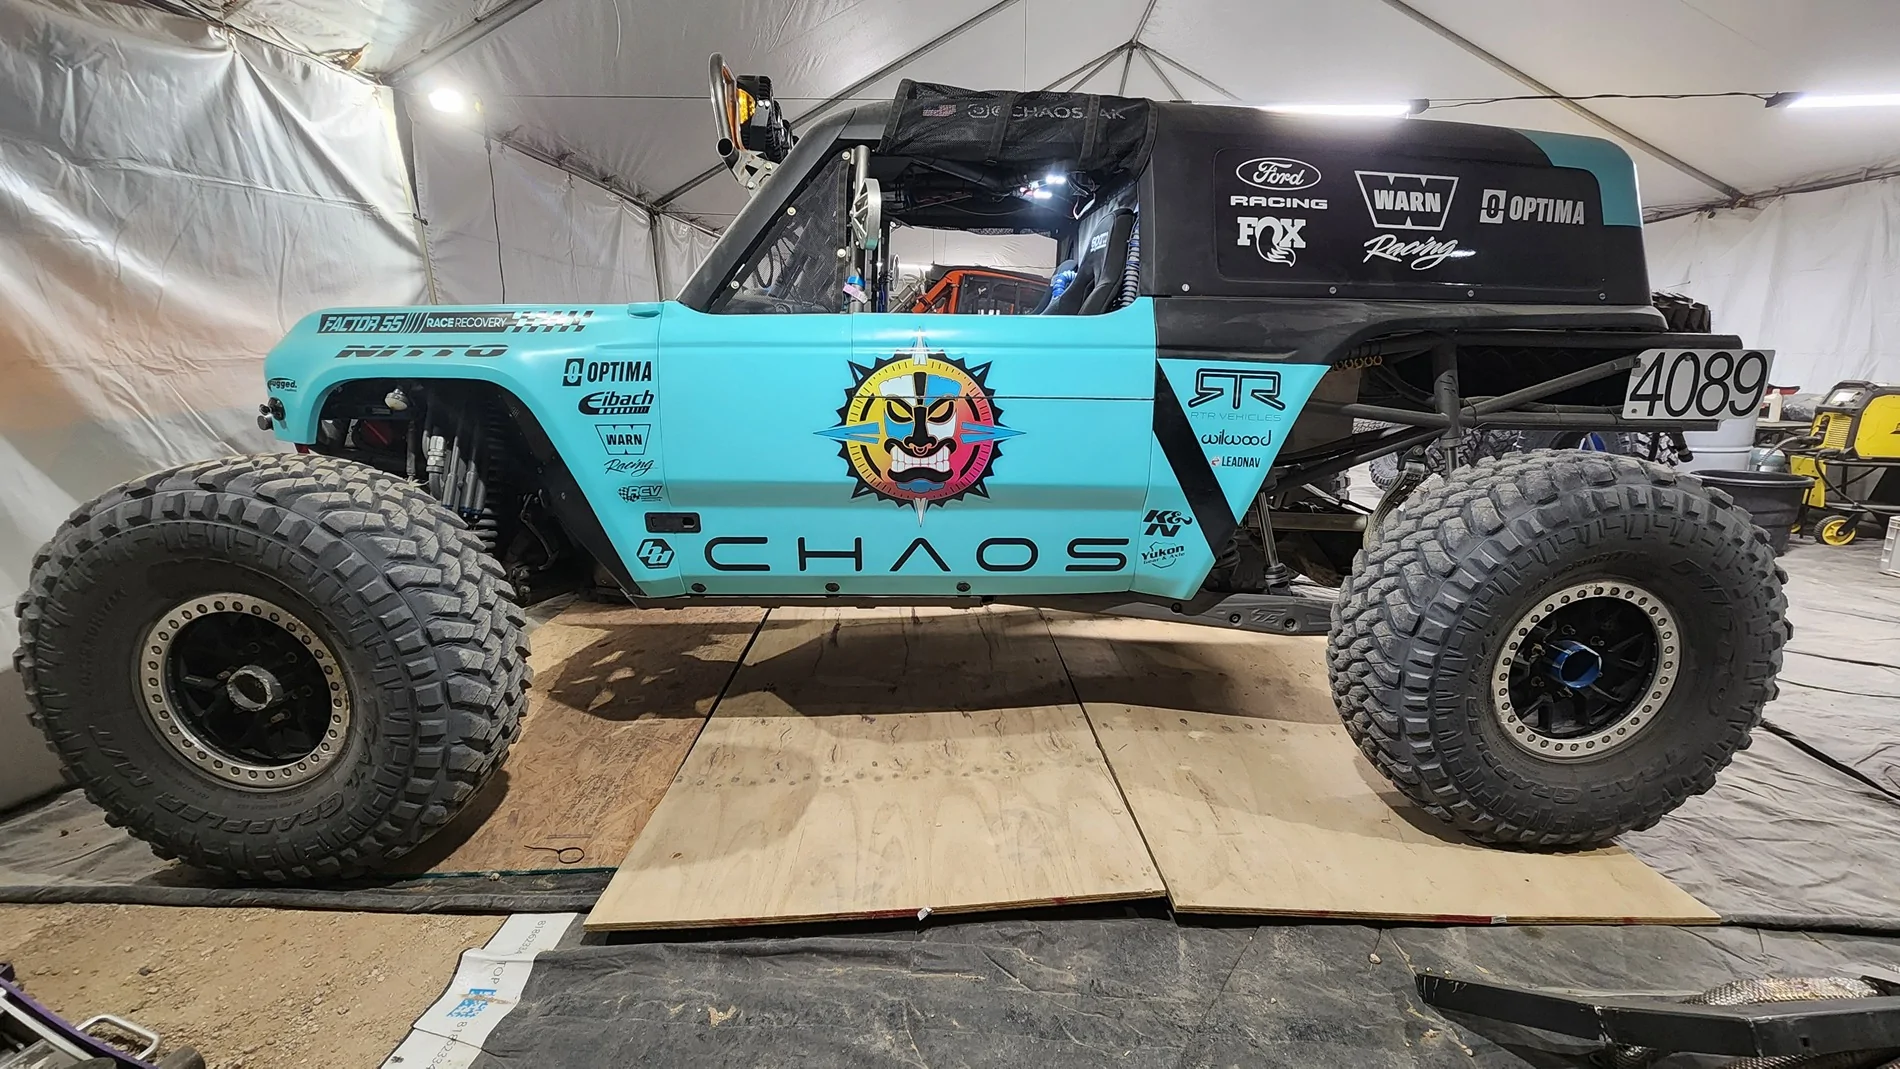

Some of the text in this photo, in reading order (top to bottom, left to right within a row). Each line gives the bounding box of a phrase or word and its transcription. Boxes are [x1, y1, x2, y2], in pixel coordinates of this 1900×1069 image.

[1253, 161, 1306, 186] Ford
[1230, 195, 1328, 210] RACING
[1373, 189, 1441, 213] WARN
[1509, 195, 1586, 225] OPTIMA
[1237, 216, 1306, 260] FOX
[1363, 234, 1460, 271] Racing
[320, 315, 507, 332] FACTOR 55 RACE RECOVERY
[334, 344, 509, 359] NITTO
[587, 361, 652, 383] OPTIMA
[1187, 368, 1286, 411] RTR
[1629, 351, 1767, 418] 4089
[578, 389, 655, 415] Eibach
[1190, 411, 1282, 422] RTR VEHICLES
[606, 433, 643, 446] WARN
[1201, 429, 1272, 447] wilwood
[603, 458, 655, 478] Racing
[1221, 456, 1261, 468] LEADNAV
[703, 536, 1130, 572] CHAOS
[1141, 545, 1185, 561] Yukon
[155, 791, 345, 834] GRAPPLER
[491, 961, 508, 985] TOP
